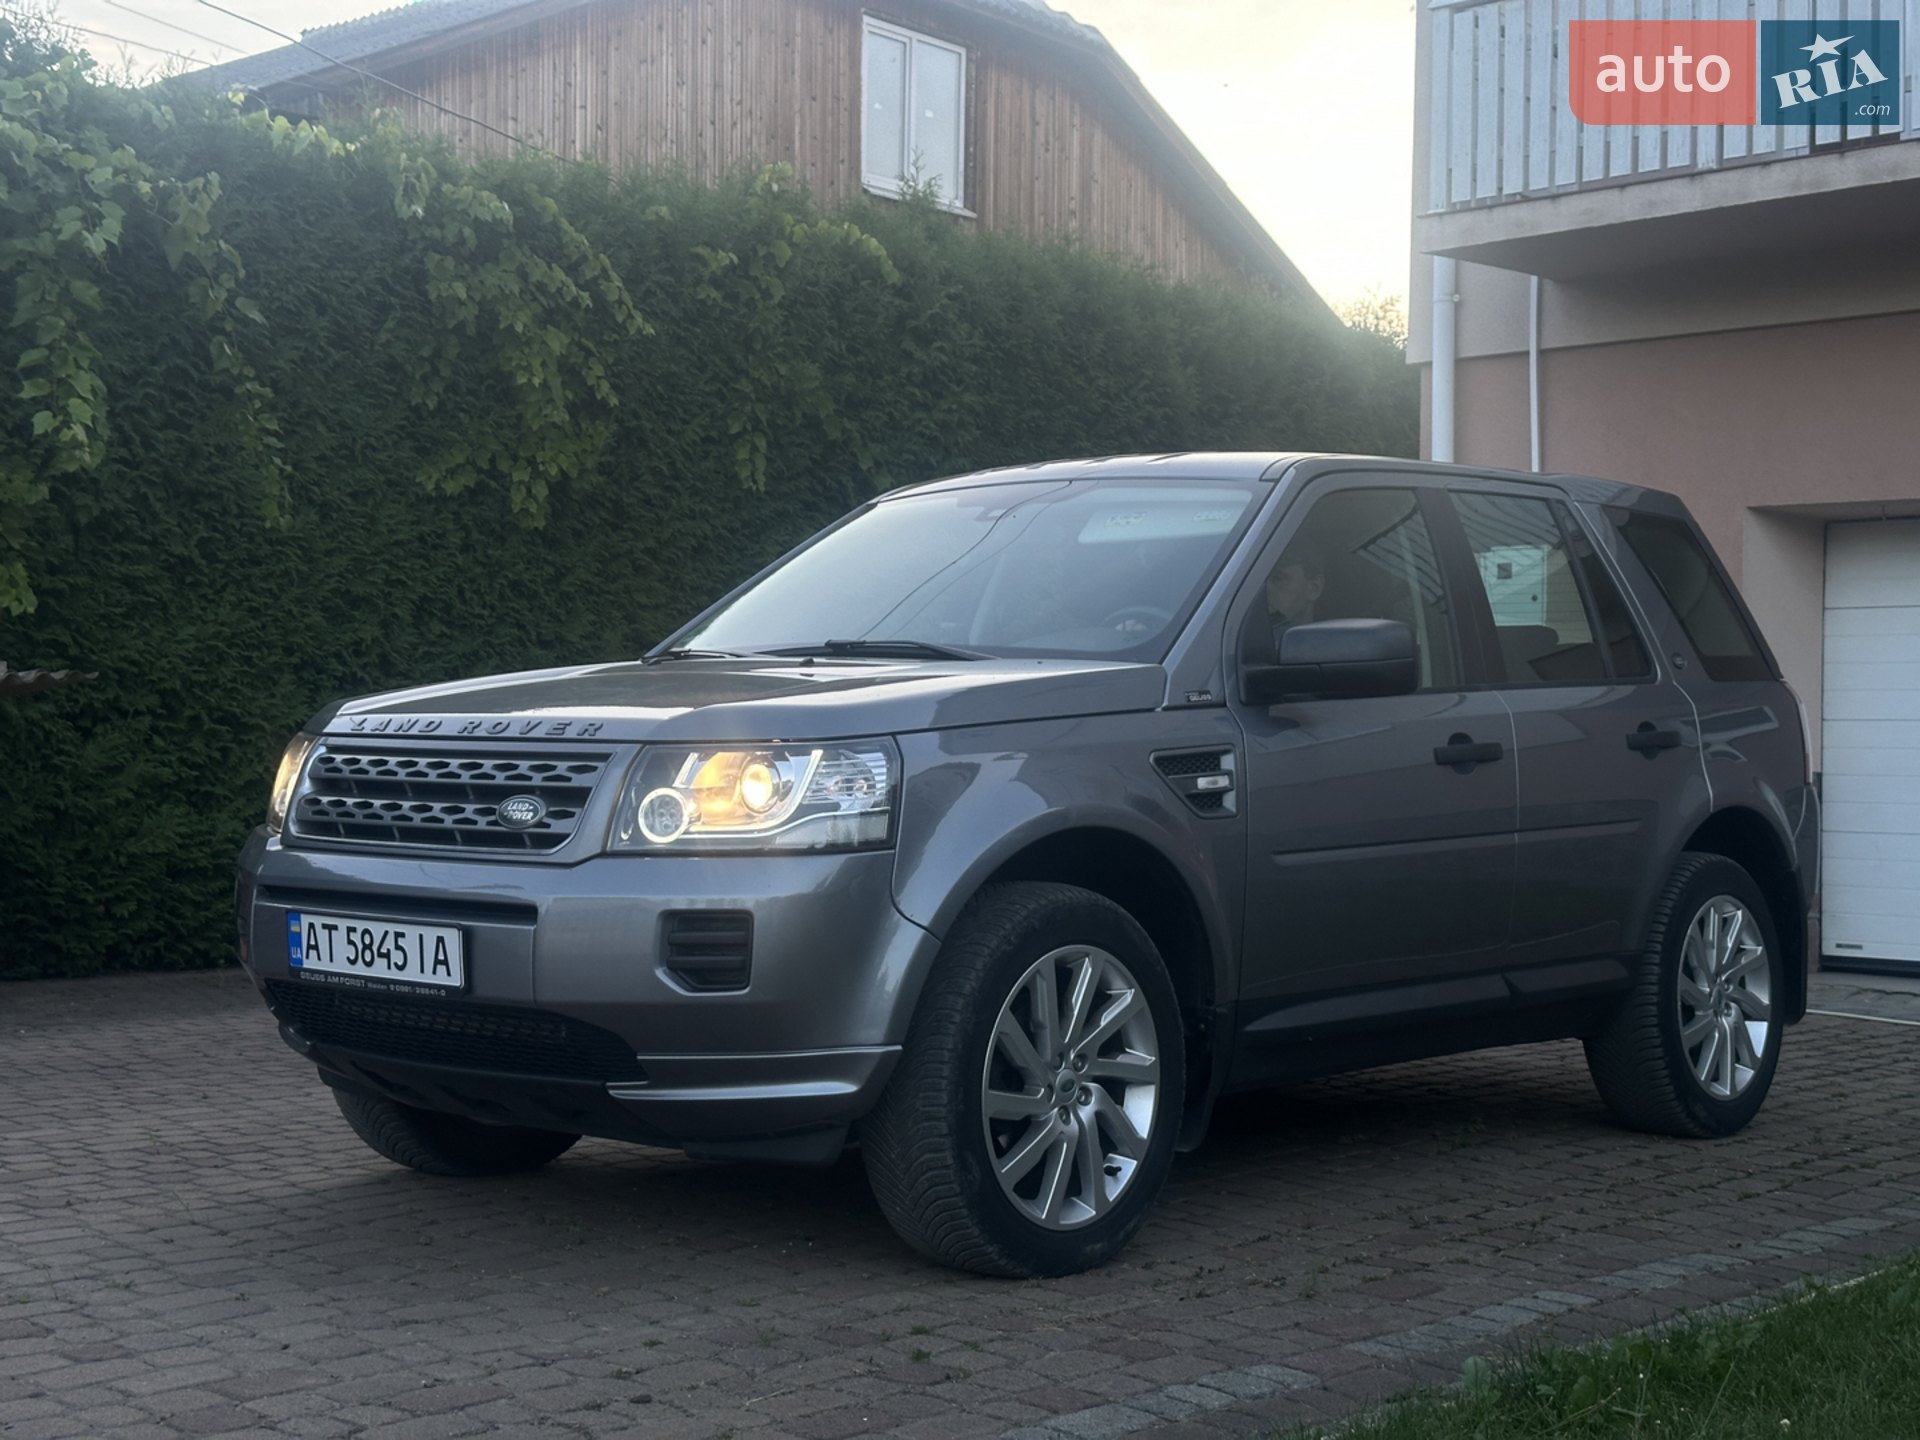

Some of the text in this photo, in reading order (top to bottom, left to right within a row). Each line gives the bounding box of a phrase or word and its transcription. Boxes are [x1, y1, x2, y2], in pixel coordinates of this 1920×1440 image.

[350, 716, 604, 737] LAND ROVER
[291, 946, 303, 959] UA
[305, 921, 452, 977] AT 5845 IA
